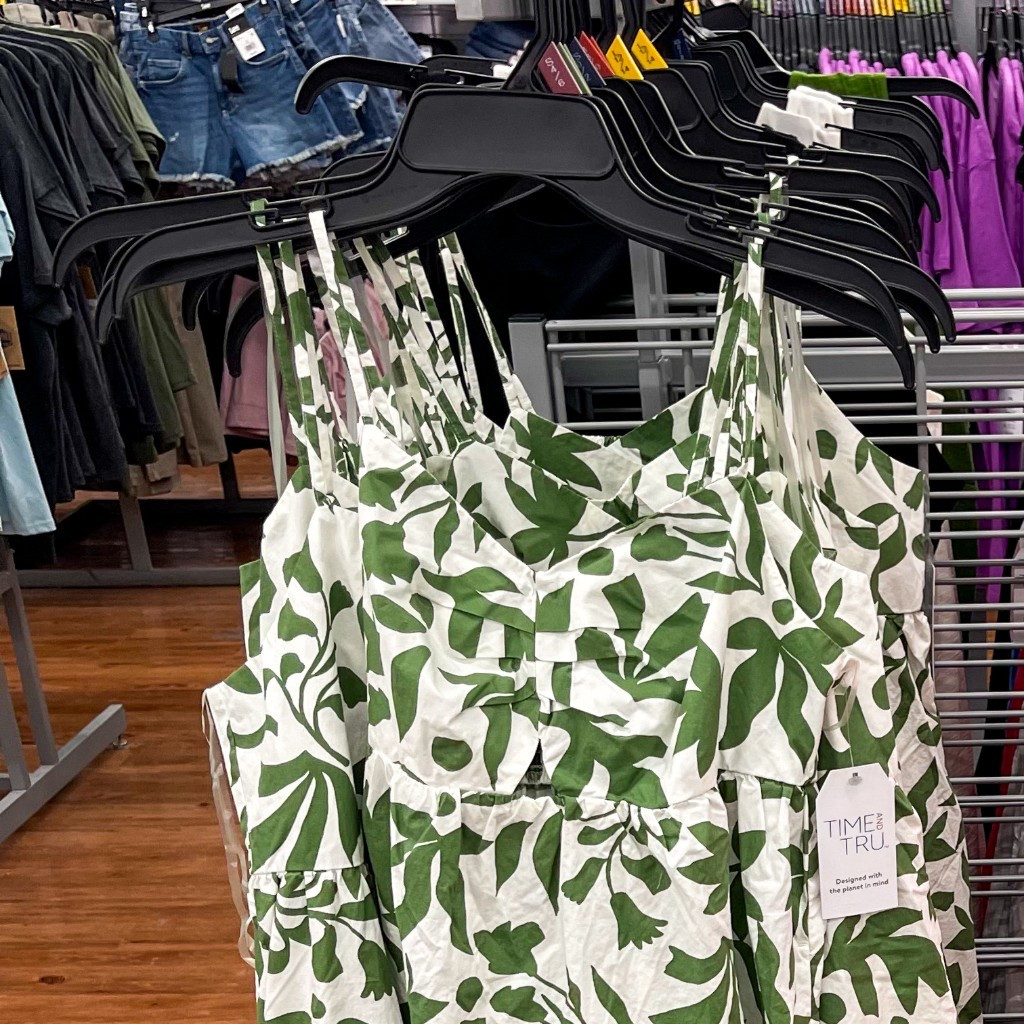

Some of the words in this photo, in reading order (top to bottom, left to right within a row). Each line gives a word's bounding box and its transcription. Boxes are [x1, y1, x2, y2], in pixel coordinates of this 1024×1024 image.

[824, 813, 875, 838] TIME
[876, 812, 884, 831] AND
[840, 832, 885, 855] TRU
[829, 887, 841, 895] the
[842, 884, 864, 894] planet
[872, 878, 889, 887] mind
[835, 874, 867, 885] Designed
[868, 872, 883, 880] with
